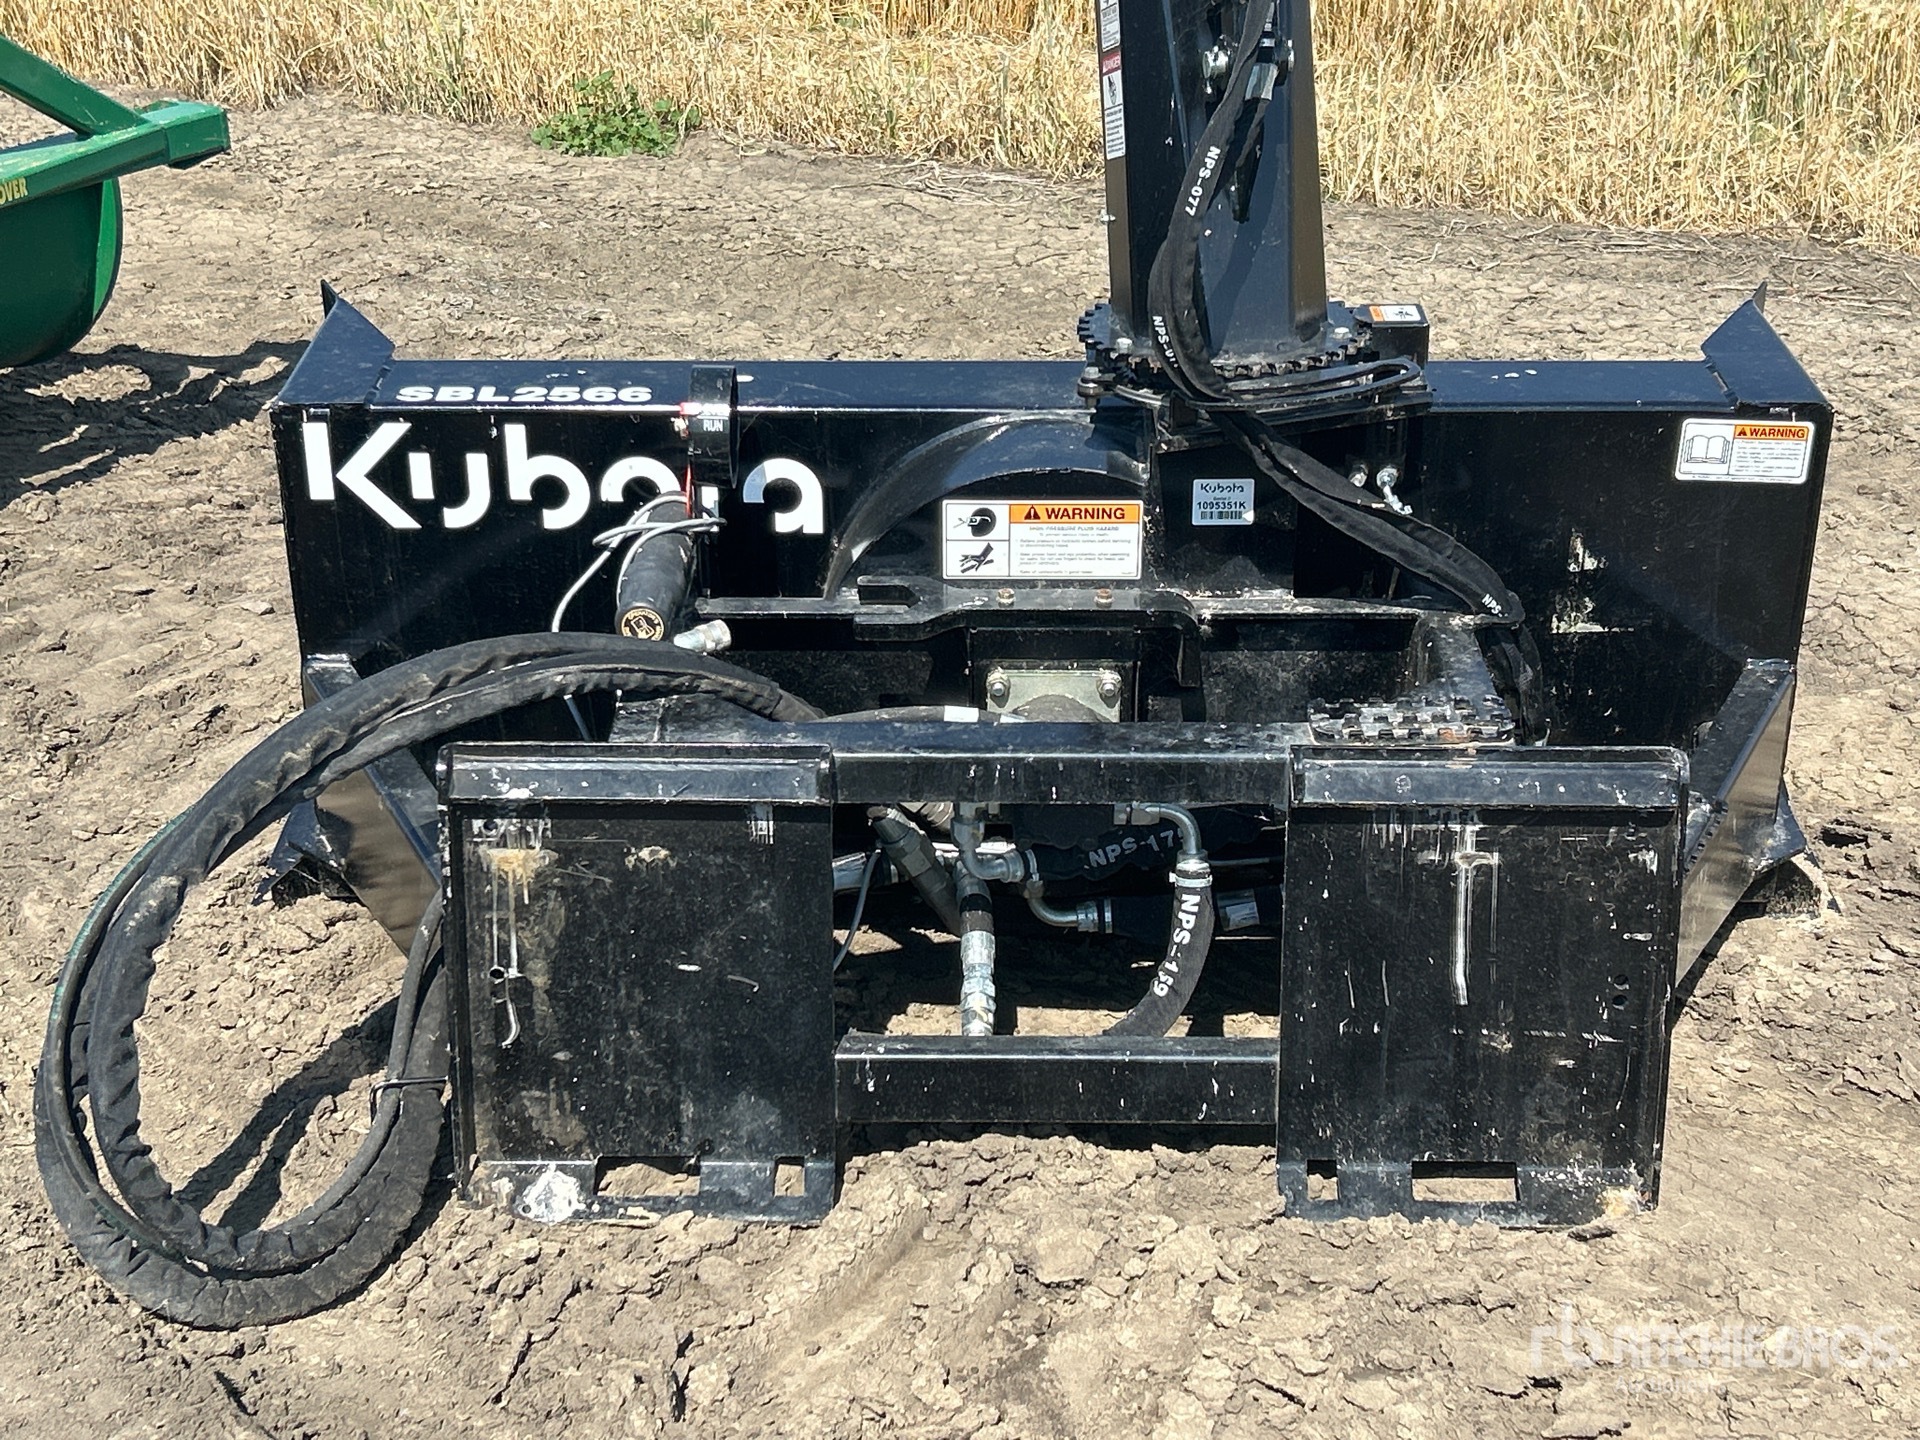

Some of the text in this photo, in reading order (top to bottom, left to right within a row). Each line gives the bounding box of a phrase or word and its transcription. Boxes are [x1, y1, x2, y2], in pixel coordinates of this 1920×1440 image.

[1185, 145, 1221, 217] NPS-077
[396, 386, 653, 403] SBL2566
[703, 419, 723, 432] RUN
[1749, 427, 1806, 439] WARNING
[1201, 483, 1244, 493] Kubota
[1197, 501, 1247, 510] 1095351K
[1045, 507, 1126, 520] WARNING
[1088, 827, 1184, 868] NPS-17
